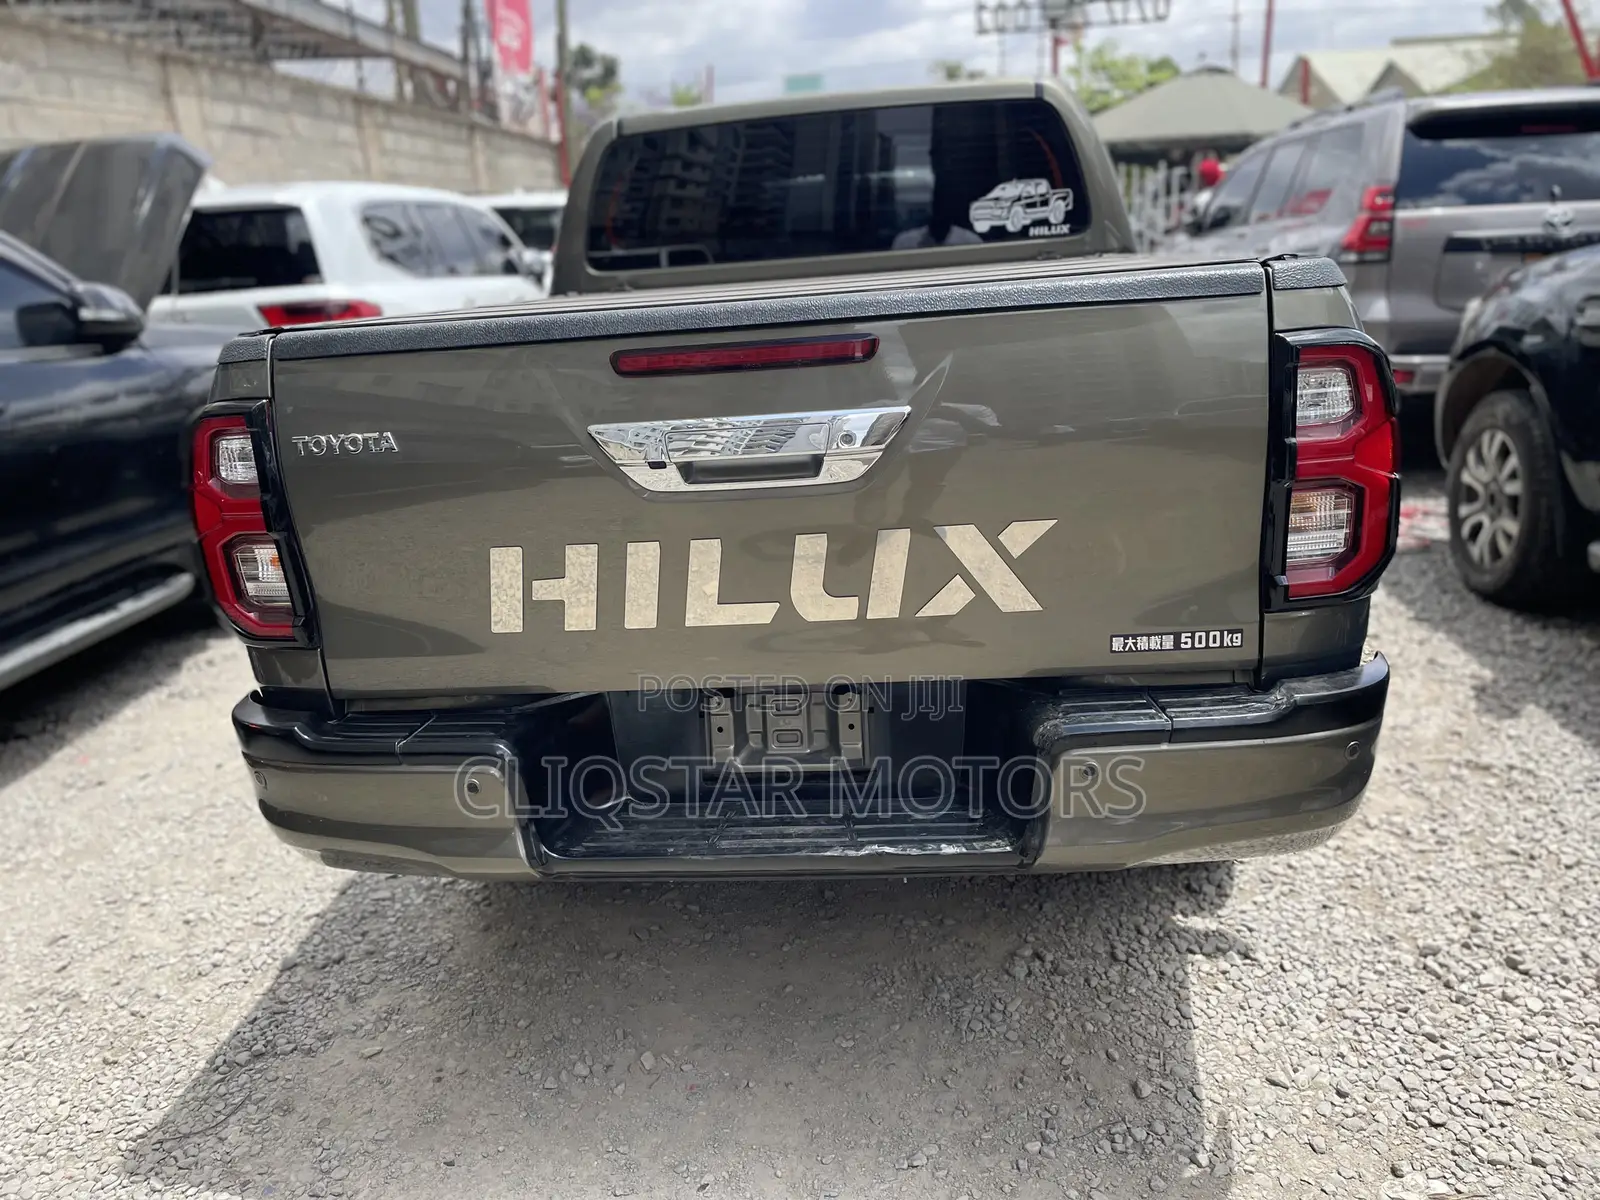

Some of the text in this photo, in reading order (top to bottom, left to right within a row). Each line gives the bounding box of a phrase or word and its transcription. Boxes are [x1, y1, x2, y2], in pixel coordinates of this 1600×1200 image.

[1029, 223, 1071, 237] HILUX
[291, 431, 399, 456] TOYOTA
[489, 519, 1059, 633] HILUX
[1111, 630, 1242, 652] 最大積載量 500kg
